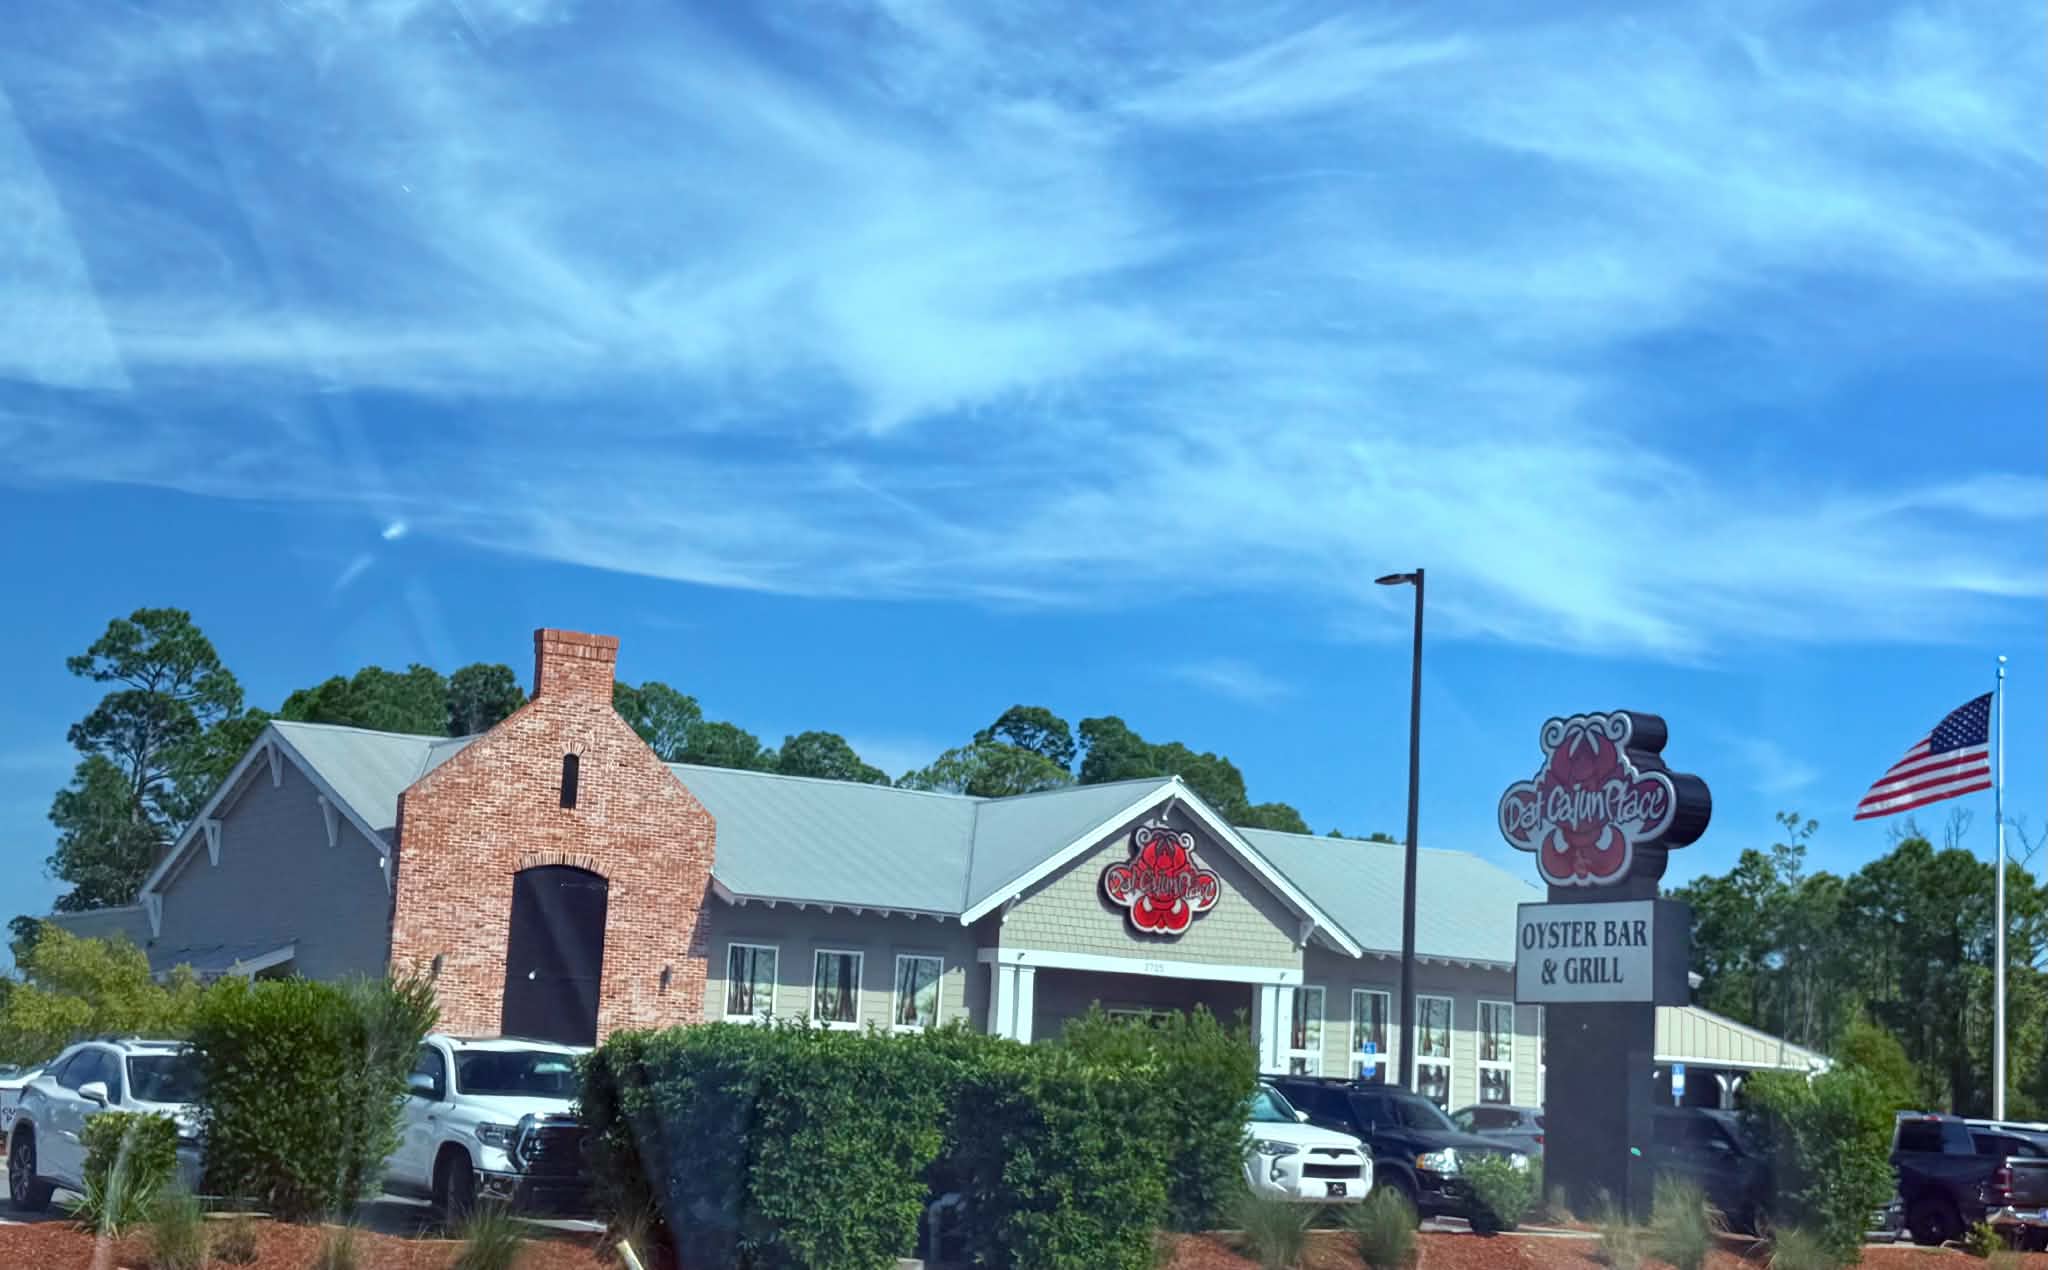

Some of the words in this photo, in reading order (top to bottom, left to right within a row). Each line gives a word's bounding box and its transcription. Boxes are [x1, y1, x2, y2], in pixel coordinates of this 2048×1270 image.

[1507, 790, 1543, 833] Dat
[1548, 783, 1602, 830] Cajun
[1601, 779, 1667, 824] Place
[1523, 920, 1597, 950] OYSTER
[1603, 920, 1648, 948] BAR
[1541, 958, 1557, 985] &
[1563, 956, 1623, 984] GRILL
